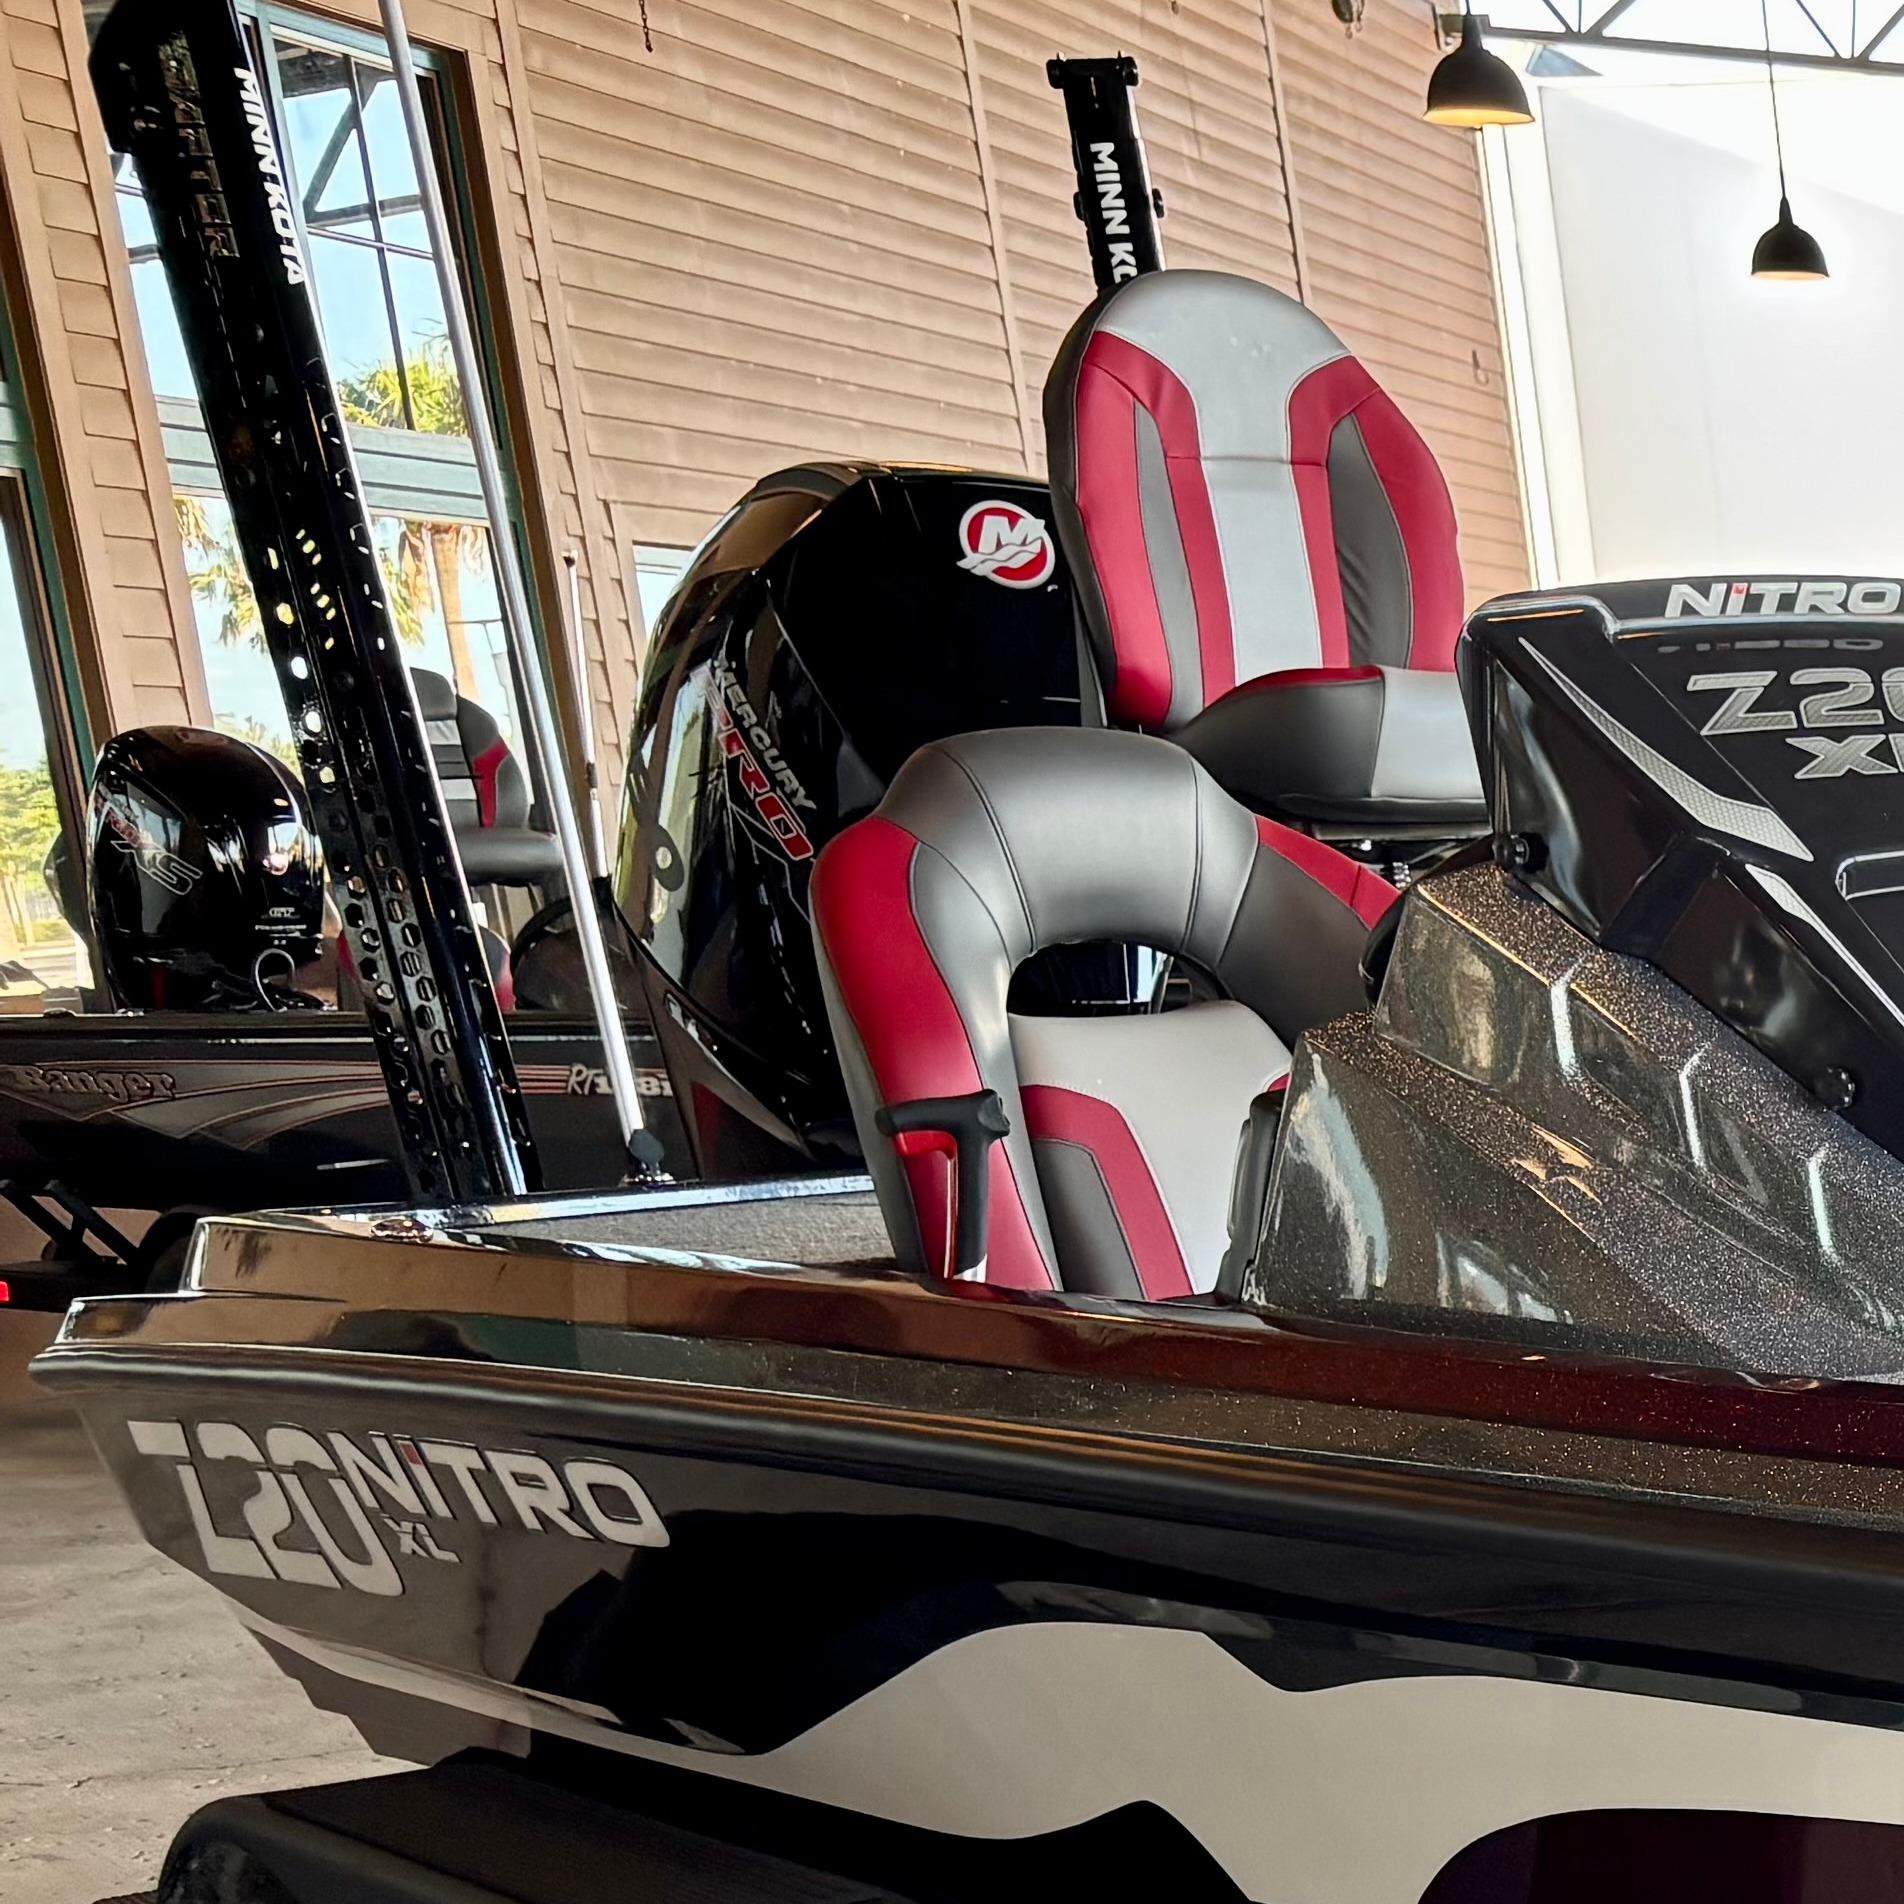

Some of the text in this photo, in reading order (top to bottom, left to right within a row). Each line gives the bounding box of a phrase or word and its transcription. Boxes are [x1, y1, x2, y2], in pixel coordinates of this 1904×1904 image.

[233, 67, 305, 285] MINN KOTA
[1089, 142, 1138, 284] MINN KO
[1664, 581, 1902, 618] NITRO
[714, 664, 817, 810] MERCURY
[127, 1420, 405, 1597] Z20
[326, 1430, 671, 1548] NITRO
[383, 1513, 462, 1563] XL
